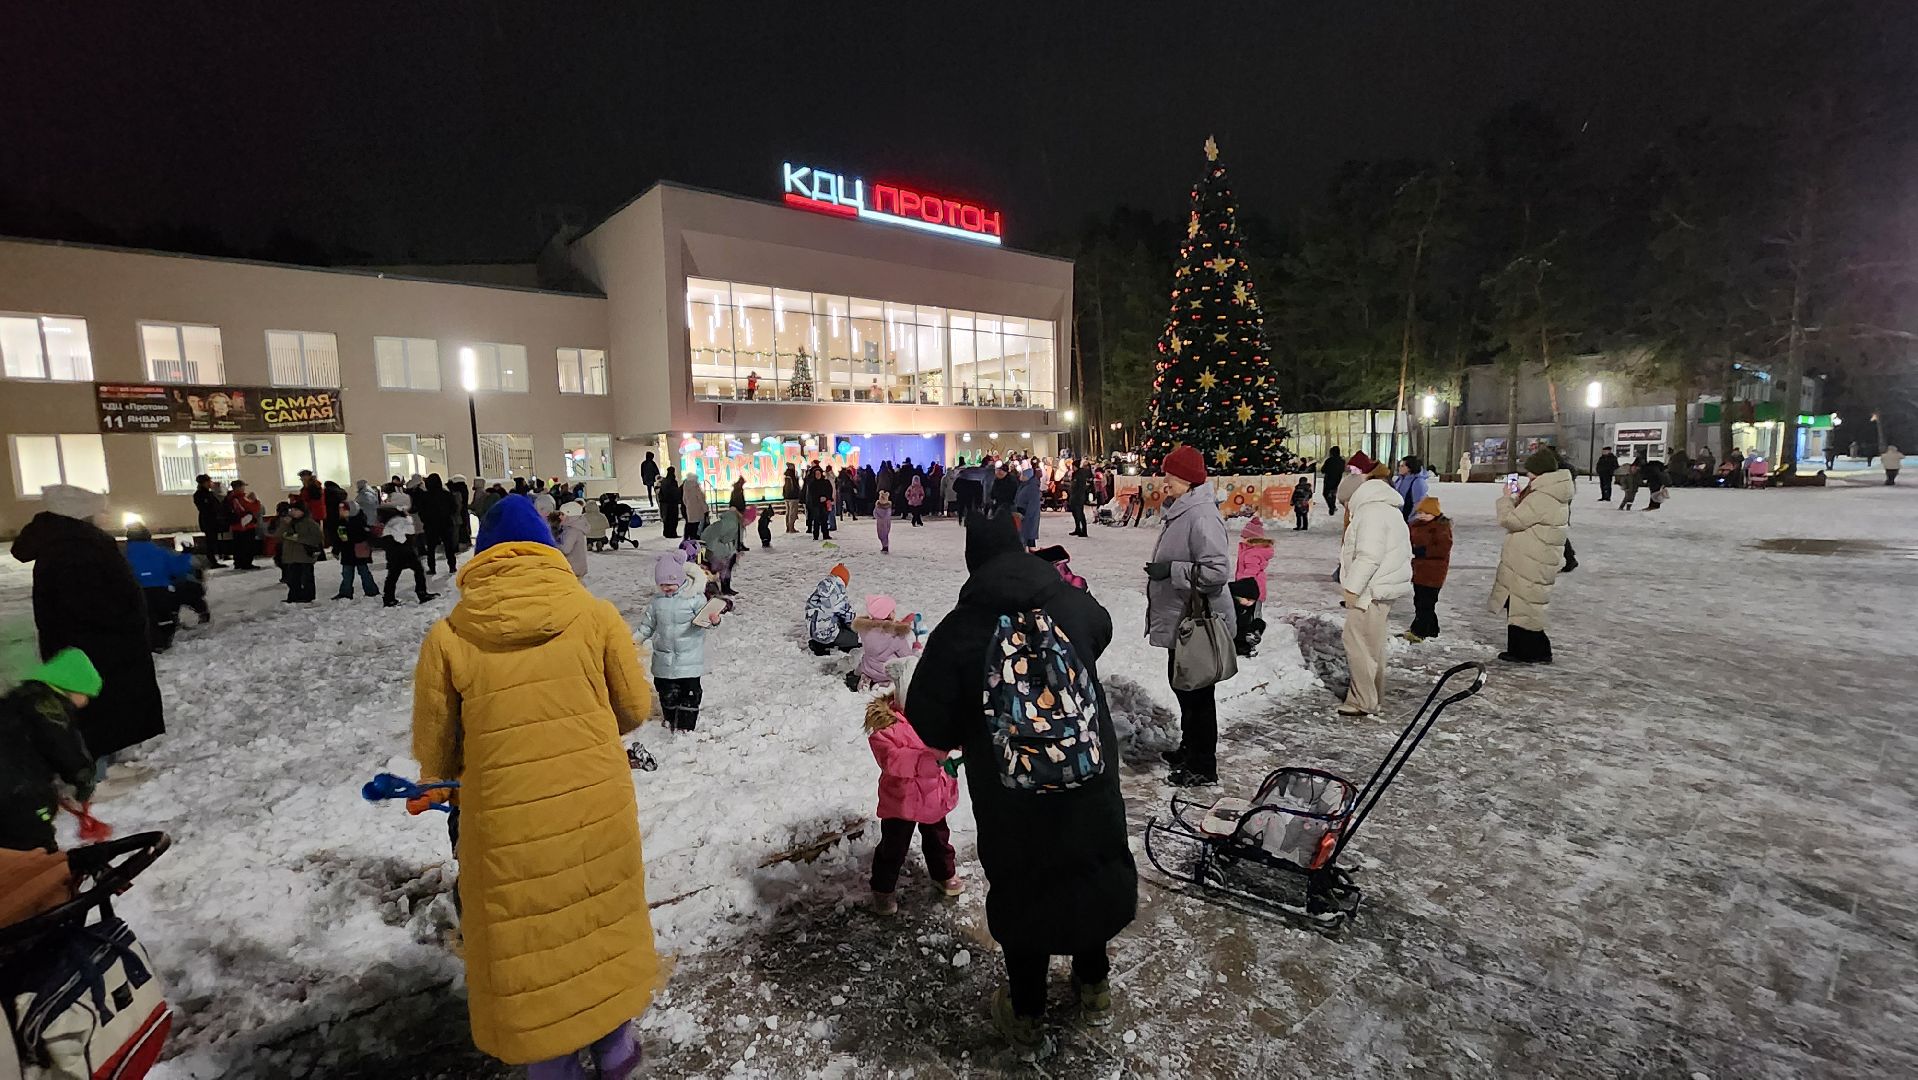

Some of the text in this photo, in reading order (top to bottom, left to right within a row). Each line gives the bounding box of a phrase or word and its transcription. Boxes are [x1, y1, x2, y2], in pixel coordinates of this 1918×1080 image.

[784, 162, 1001, 235] КДЦ ПРОТОН
[102, 402, 123, 411] КДЦ
[261, 394, 336, 410] САМАЯ-
[104, 415, 171, 428] 11 ЯНВАРЯ
[265, 406, 333, 423] САМАЯ
